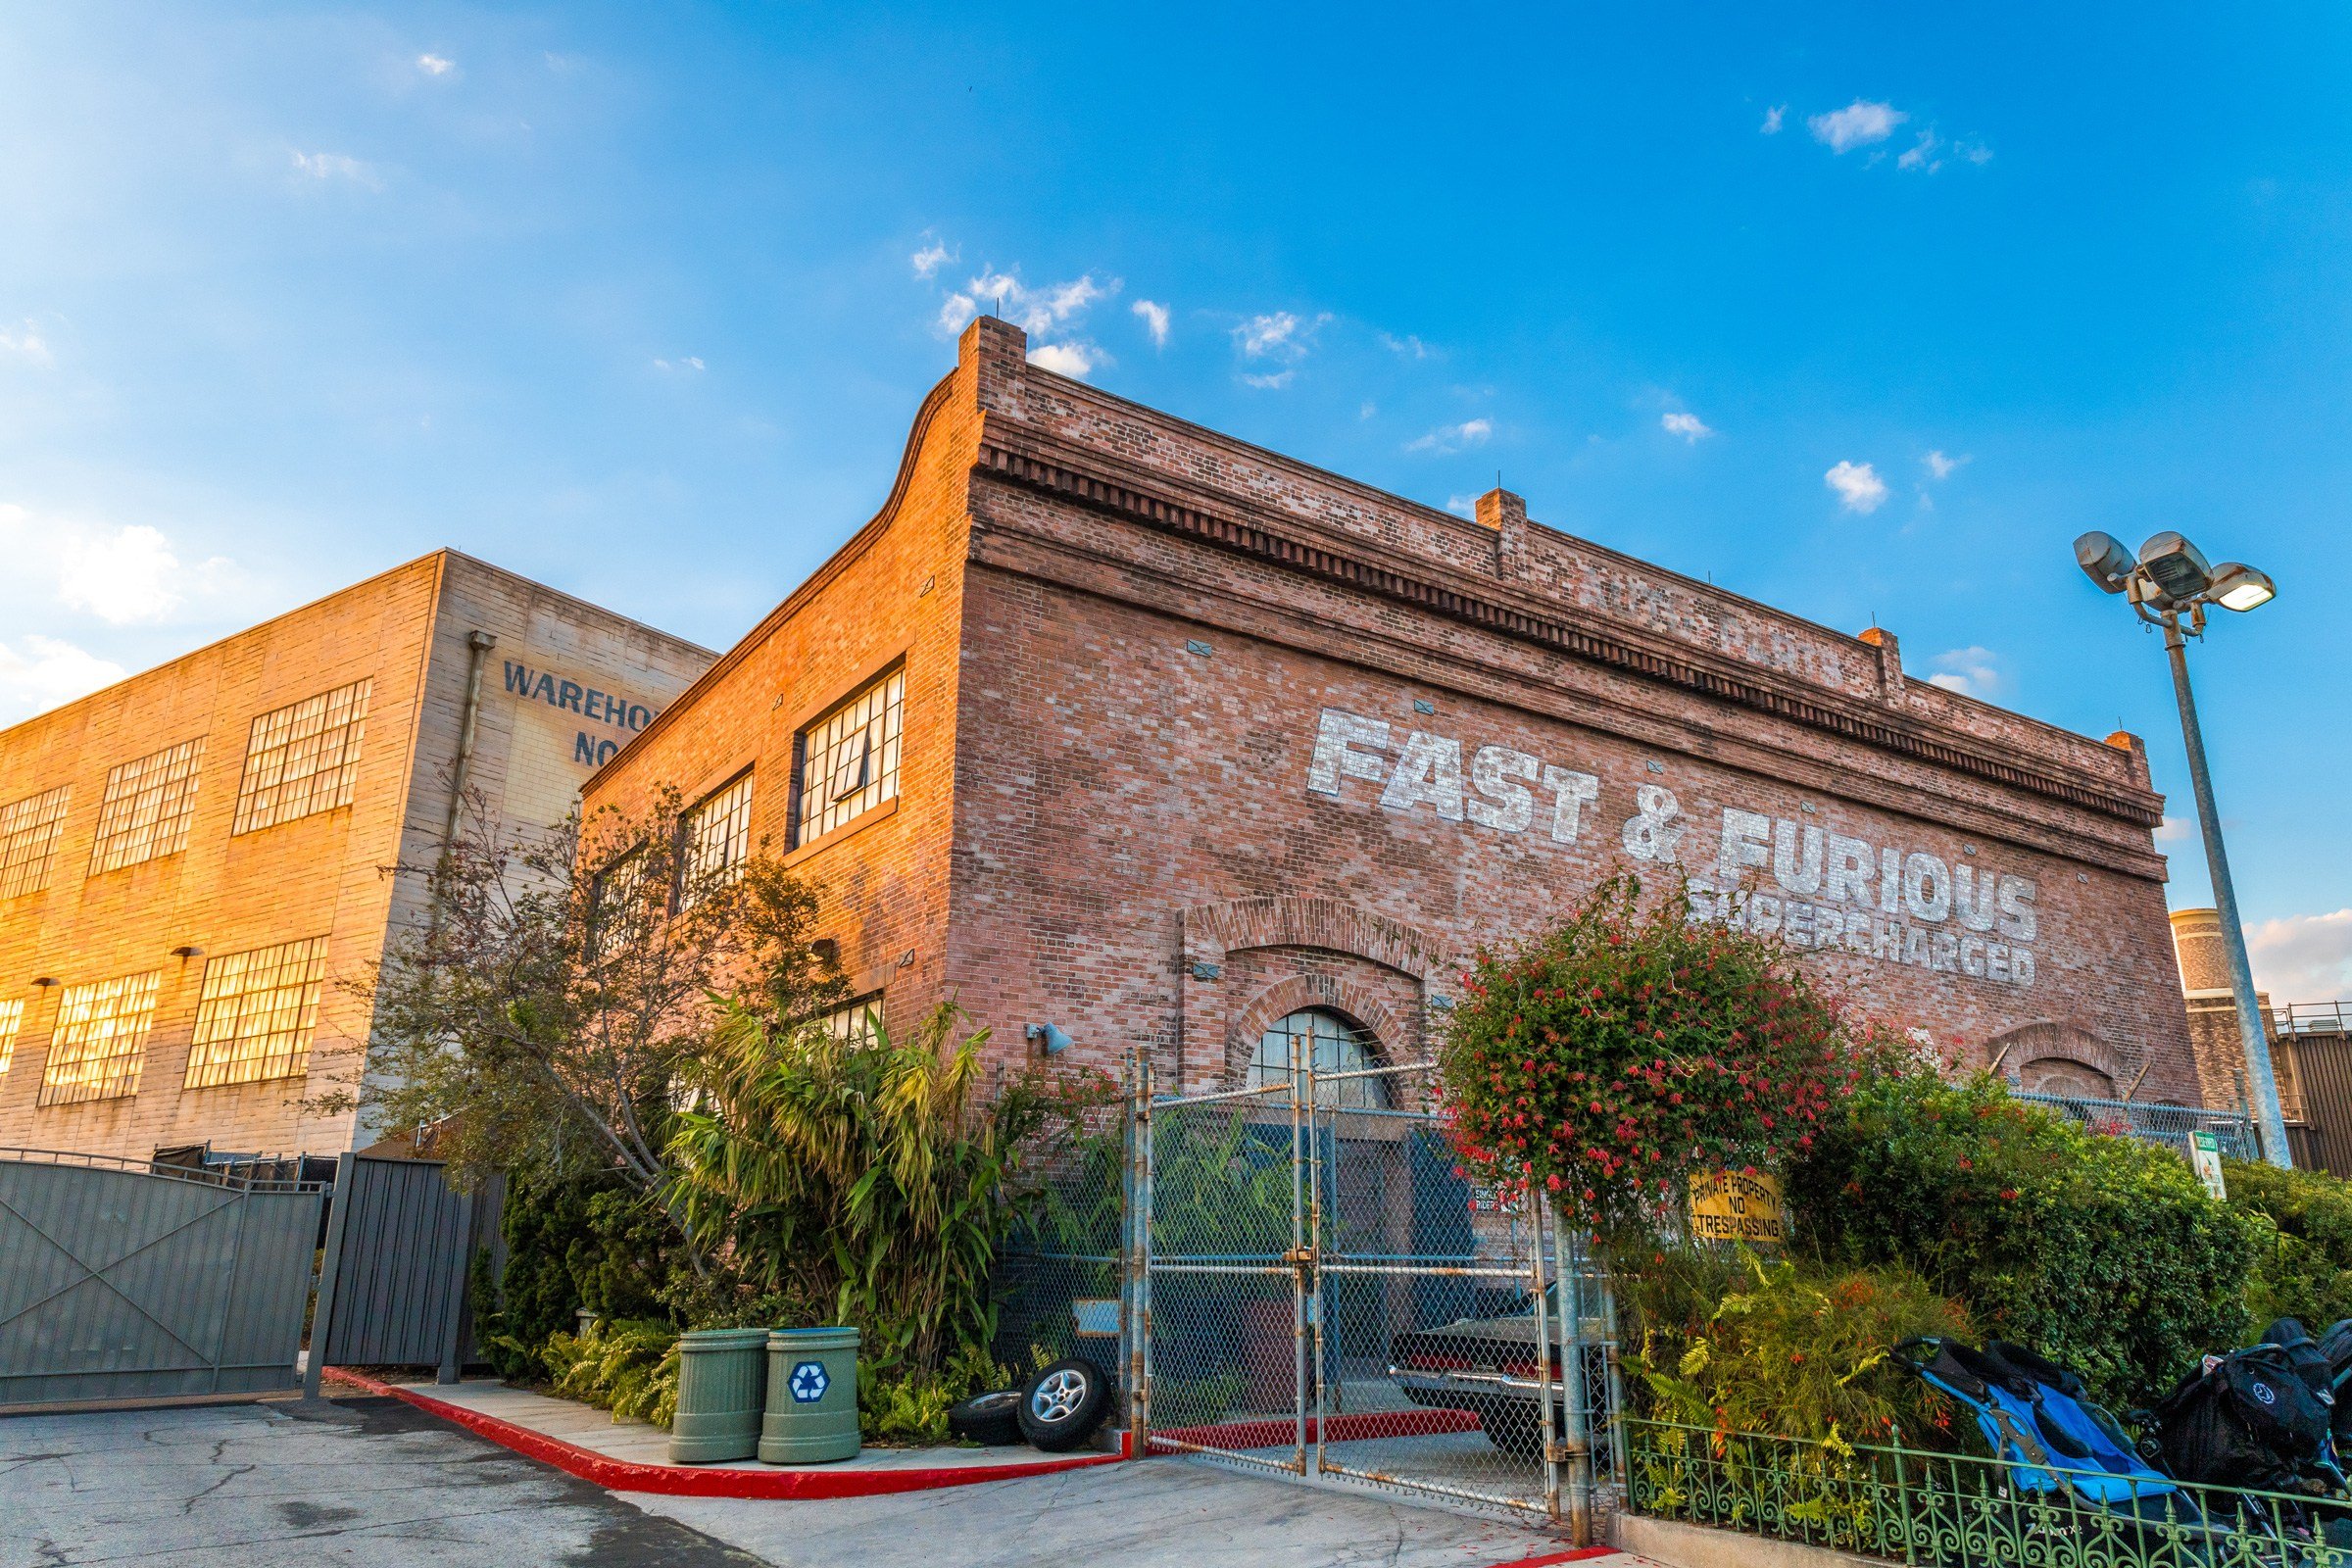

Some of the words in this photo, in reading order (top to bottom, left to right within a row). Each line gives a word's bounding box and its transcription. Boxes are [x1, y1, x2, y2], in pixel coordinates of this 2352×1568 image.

[504, 660, 663, 732] WAREHO
[1306, 708, 1599, 844] FAST
[1621, 783, 1687, 862] &
[1718, 805, 2038, 944] FURIOUS
[1686, 878, 2036, 987] SUPERCHARGED
[1693, 1176, 1729, 1207] PRIVATE
[1732, 1175, 1776, 1212] PROPERTY
[1729, 1196, 1745, 1214] NO
[1697, 1214, 1780, 1238] TRESPASSING
